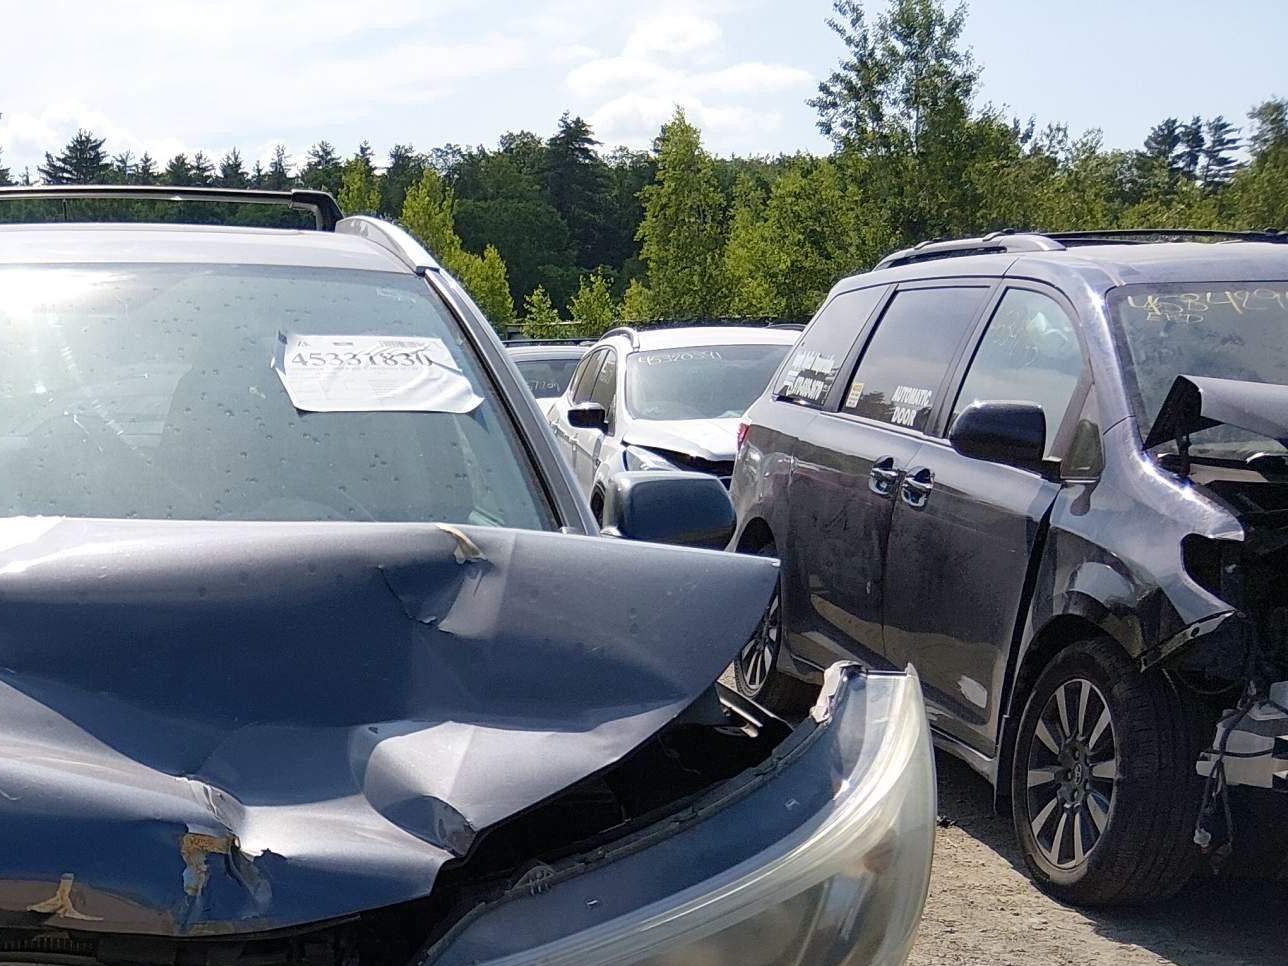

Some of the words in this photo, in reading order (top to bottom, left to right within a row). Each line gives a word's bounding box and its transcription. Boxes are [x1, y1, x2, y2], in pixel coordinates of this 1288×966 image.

[291, 351, 434, 367] 45331830
[892, 385, 932, 407] AUTOMATIC
[890, 406, 917, 427] DOOR
